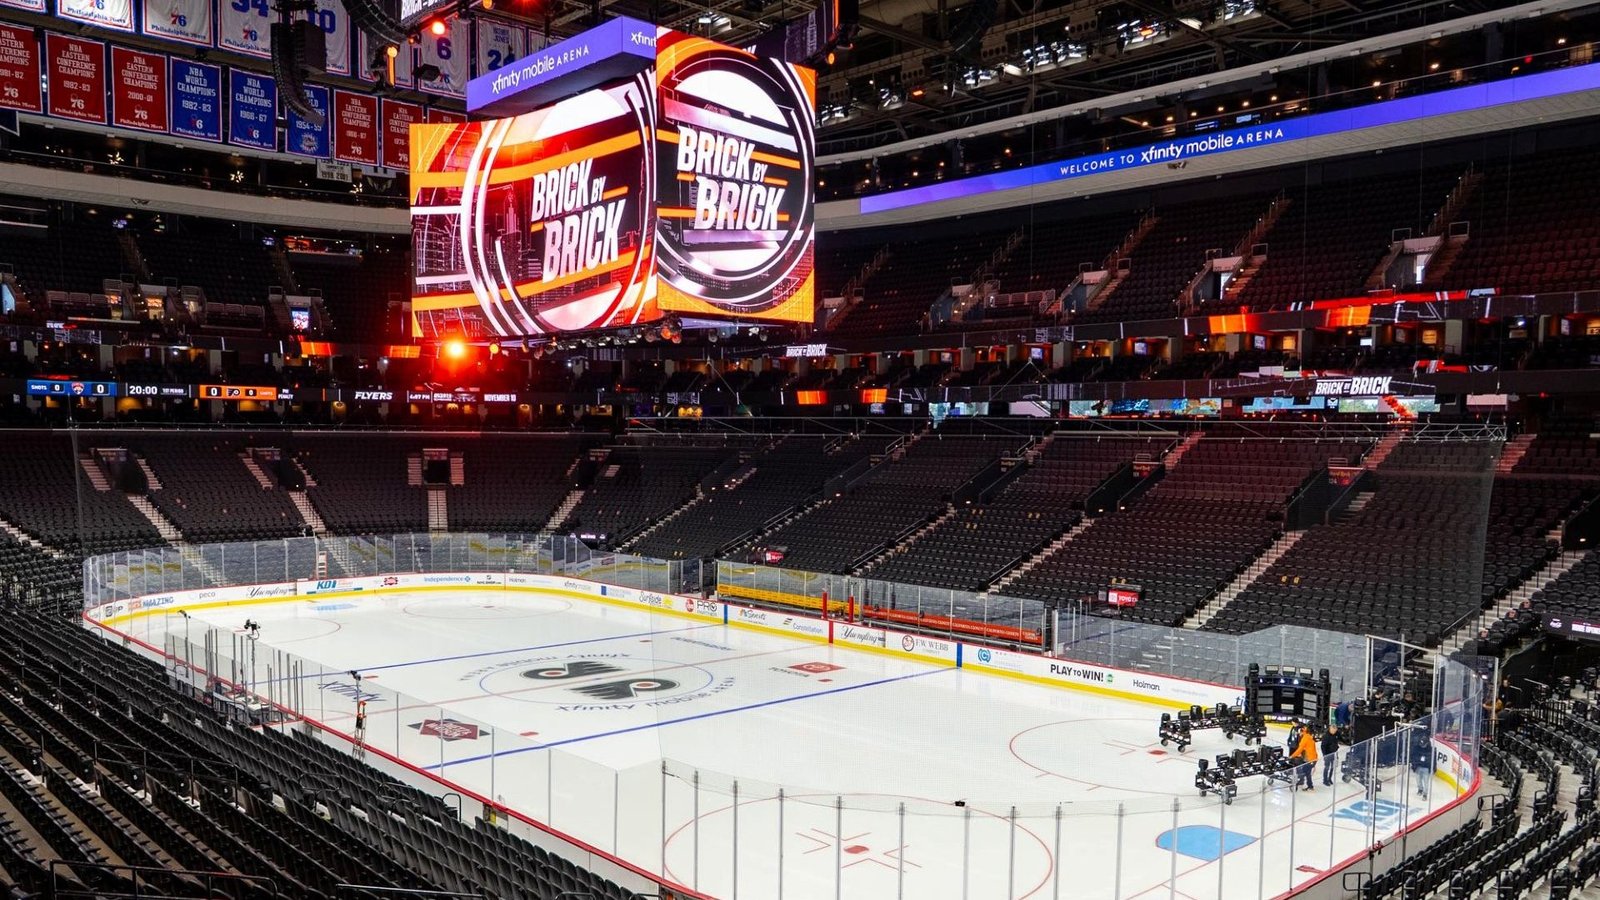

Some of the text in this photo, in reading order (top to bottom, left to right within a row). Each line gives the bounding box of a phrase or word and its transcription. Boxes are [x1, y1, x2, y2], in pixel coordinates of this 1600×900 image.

[170, 12, 187, 27] 76
[1, 30, 16, 40] NBA
[151, 24, 189, 37] Philadelphia
[243, 27, 258, 41] 76
[69, 43, 83, 53] NBA
[437, 37, 452, 60] 6
[61, 50, 91, 62] EASTERN
[133, 56, 146, 65] NBA
[56, 56, 97, 72] CONFERENCE
[126, 62, 154, 74] EASTERN
[491, 45, 590, 95] xfinity mobile ARENA
[58, 65, 95, 79] CHAMPIONS
[121, 69, 159, 83] CONFERENCE
[189, 66, 204, 77] NBA
[123, 77, 158, 91] CHAMPIONS
[185, 75, 208, 88] WORLD
[247, 77, 261, 89] NBA
[3, 87, 19, 98] 76
[177, 82, 217, 98] CHAMPIONS
[243, 86, 265, 98] WORLD
[70, 98, 85, 110] 76
[235, 93, 272, 108] CHAMPIONS
[134, 109, 148, 121] 76
[345, 104, 368, 114] EASTERN
[341, 111, 372, 122] CONFERENCE
[343, 118, 370, 129] CHAMPIONS
[351, 145, 363, 156] 76
[677, 125, 768, 183] BRICK BY
[1060, 127, 1284, 176] WELCOME TO xfinity mobile ARENA
[531, 157, 607, 223] BRICK BY
[694, 175, 786, 231] BRICK
[543, 198, 627, 284] BRICK
[54, 384, 60, 392] 0
[96, 384, 105, 394] 0
[129, 385, 158, 395] 20:00
[1315, 381, 1344, 395] BRICK
[1350, 376, 1393, 395] BRICK
[210, 387, 218, 397] 0
[354, 391, 393, 400] FLYERS
[484, 393, 510, 402] NOVEMBER
[198, 591, 216, 599] peco
[246, 586, 289, 599] Yuengling
[841, 625, 878, 644] Yuengling
[928, 641, 950, 652] WEBB
[1050, 663, 1104, 682] PLAY TO WIN!
[1132, 679, 1161, 692] Holman
[557, 702, 636, 712] xfinity
